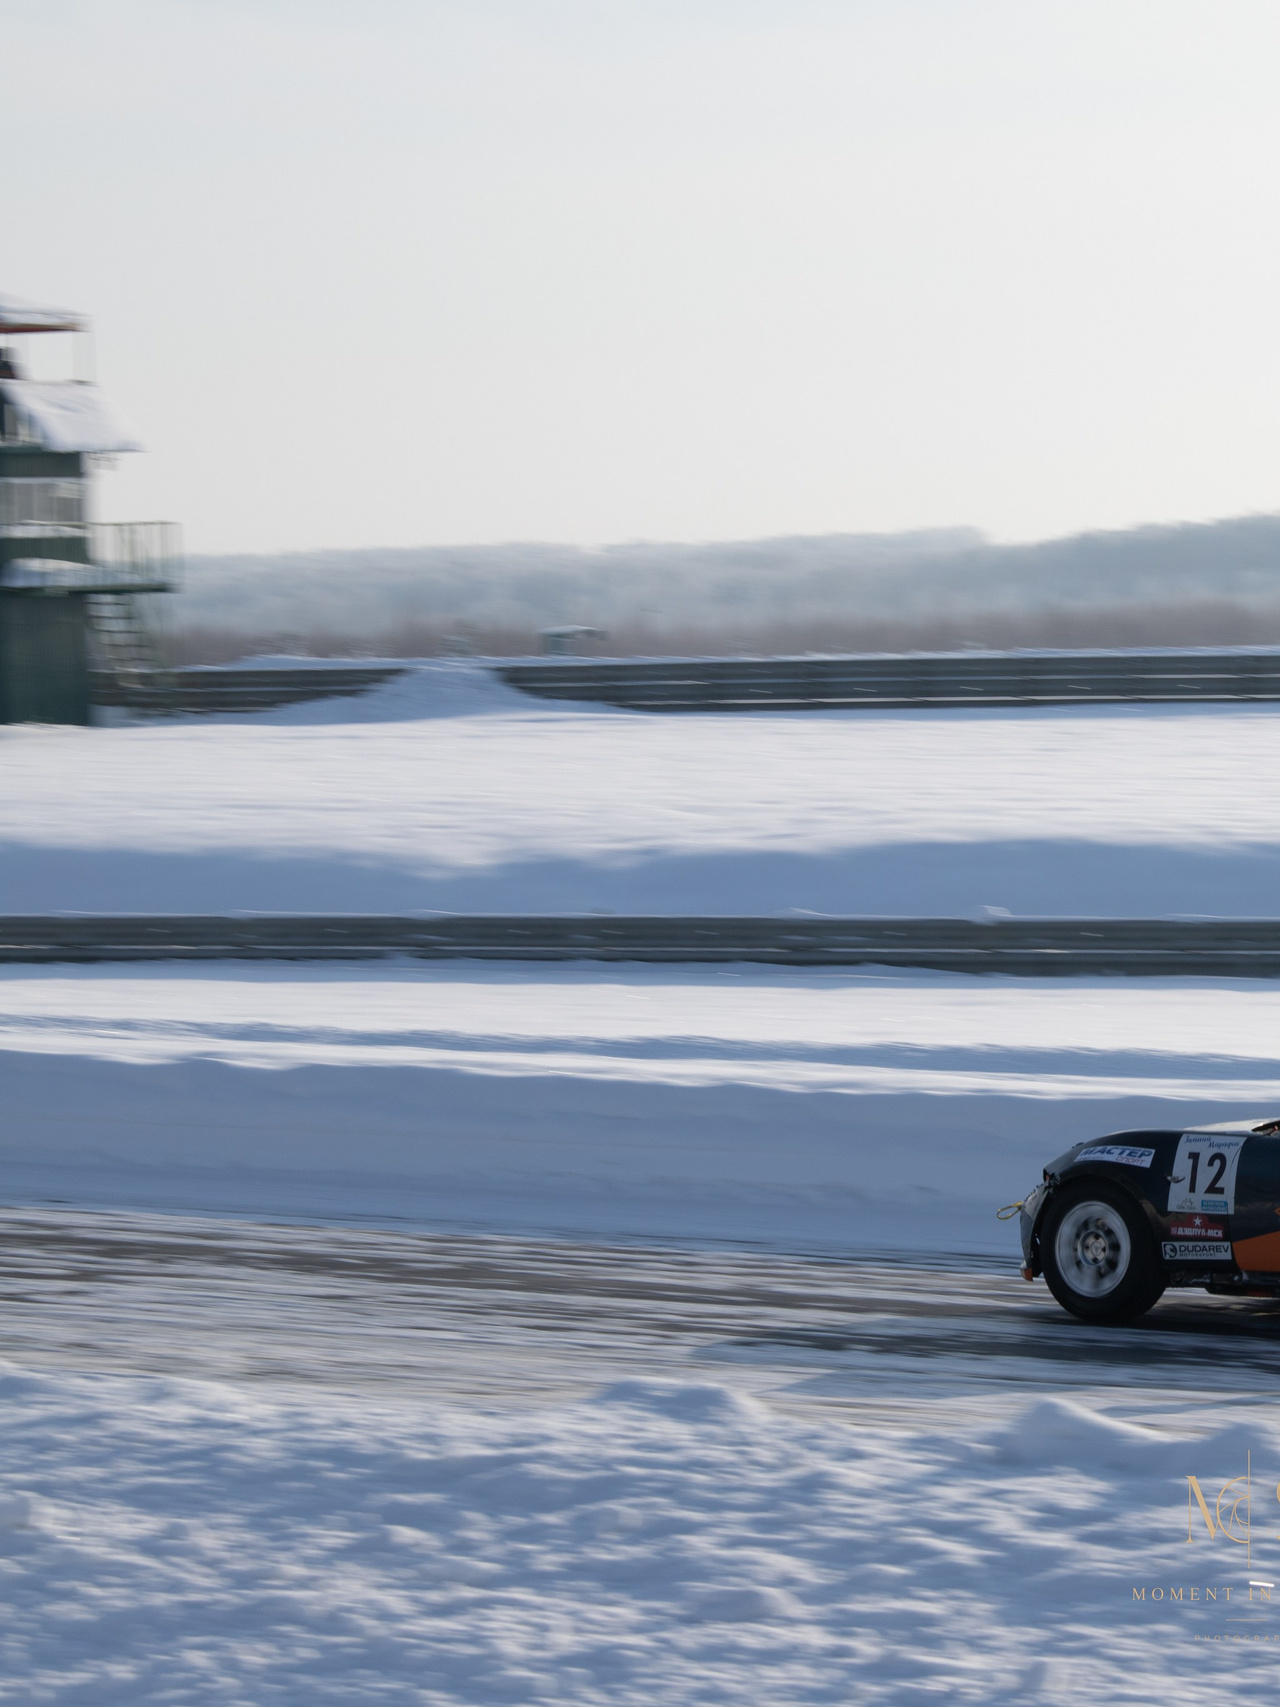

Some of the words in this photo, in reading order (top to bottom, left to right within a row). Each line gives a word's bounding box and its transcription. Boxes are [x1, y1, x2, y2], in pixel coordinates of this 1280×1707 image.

[1080, 1146, 1153, 1159] МАСТЕР
[1187, 1151, 1228, 1195] 12
[1178, 1244, 1230, 1253] DUDAREV
